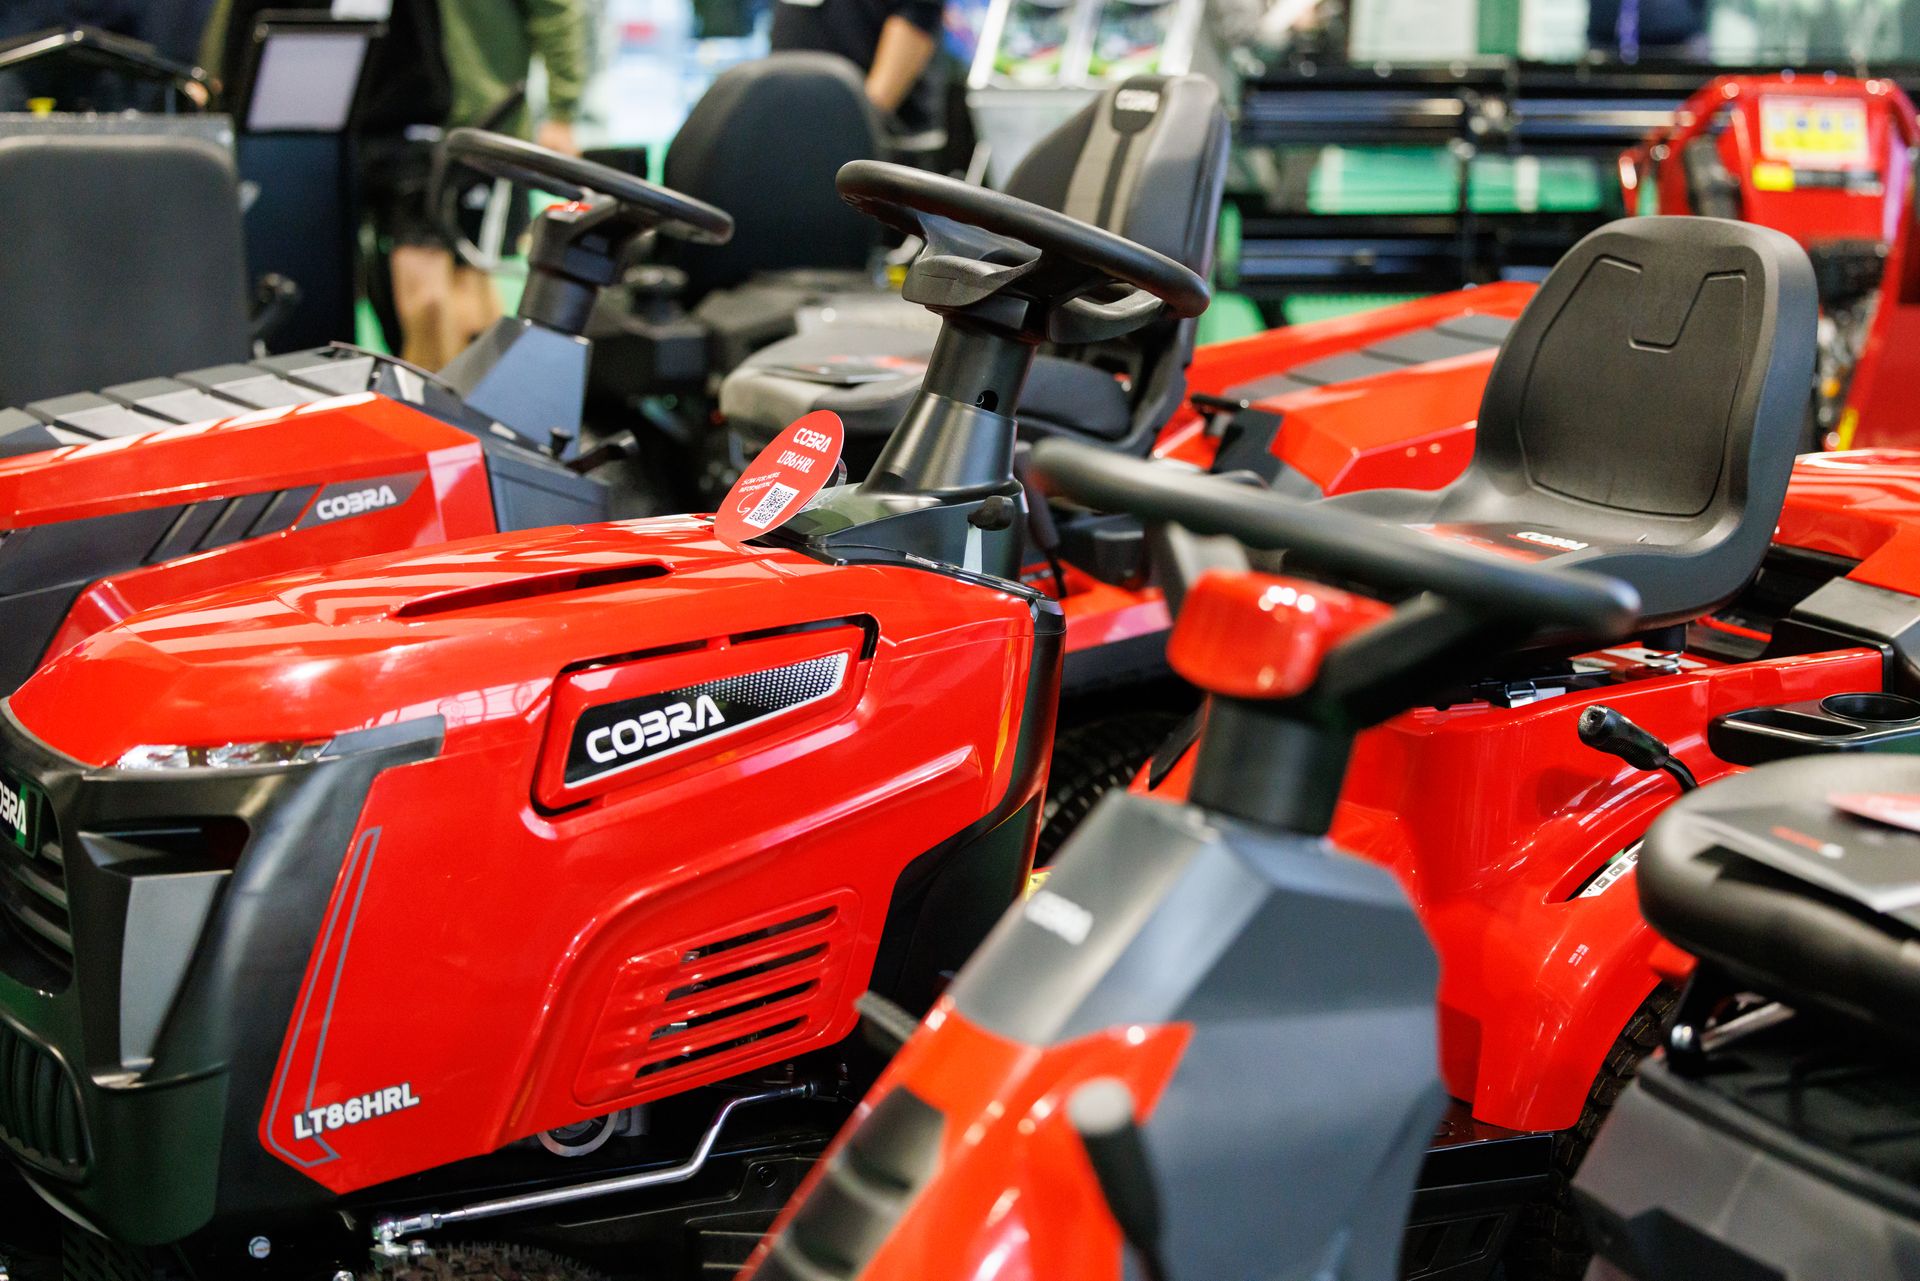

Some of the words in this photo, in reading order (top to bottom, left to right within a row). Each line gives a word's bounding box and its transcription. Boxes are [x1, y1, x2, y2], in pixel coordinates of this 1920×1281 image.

[793, 427, 832, 452] COBRA
[777, 450, 815, 473] LT86HRL
[316, 484, 397, 520] COBRA
[585, 694, 726, 763] COBRA
[293, 1081, 420, 1141] LT86HRL
